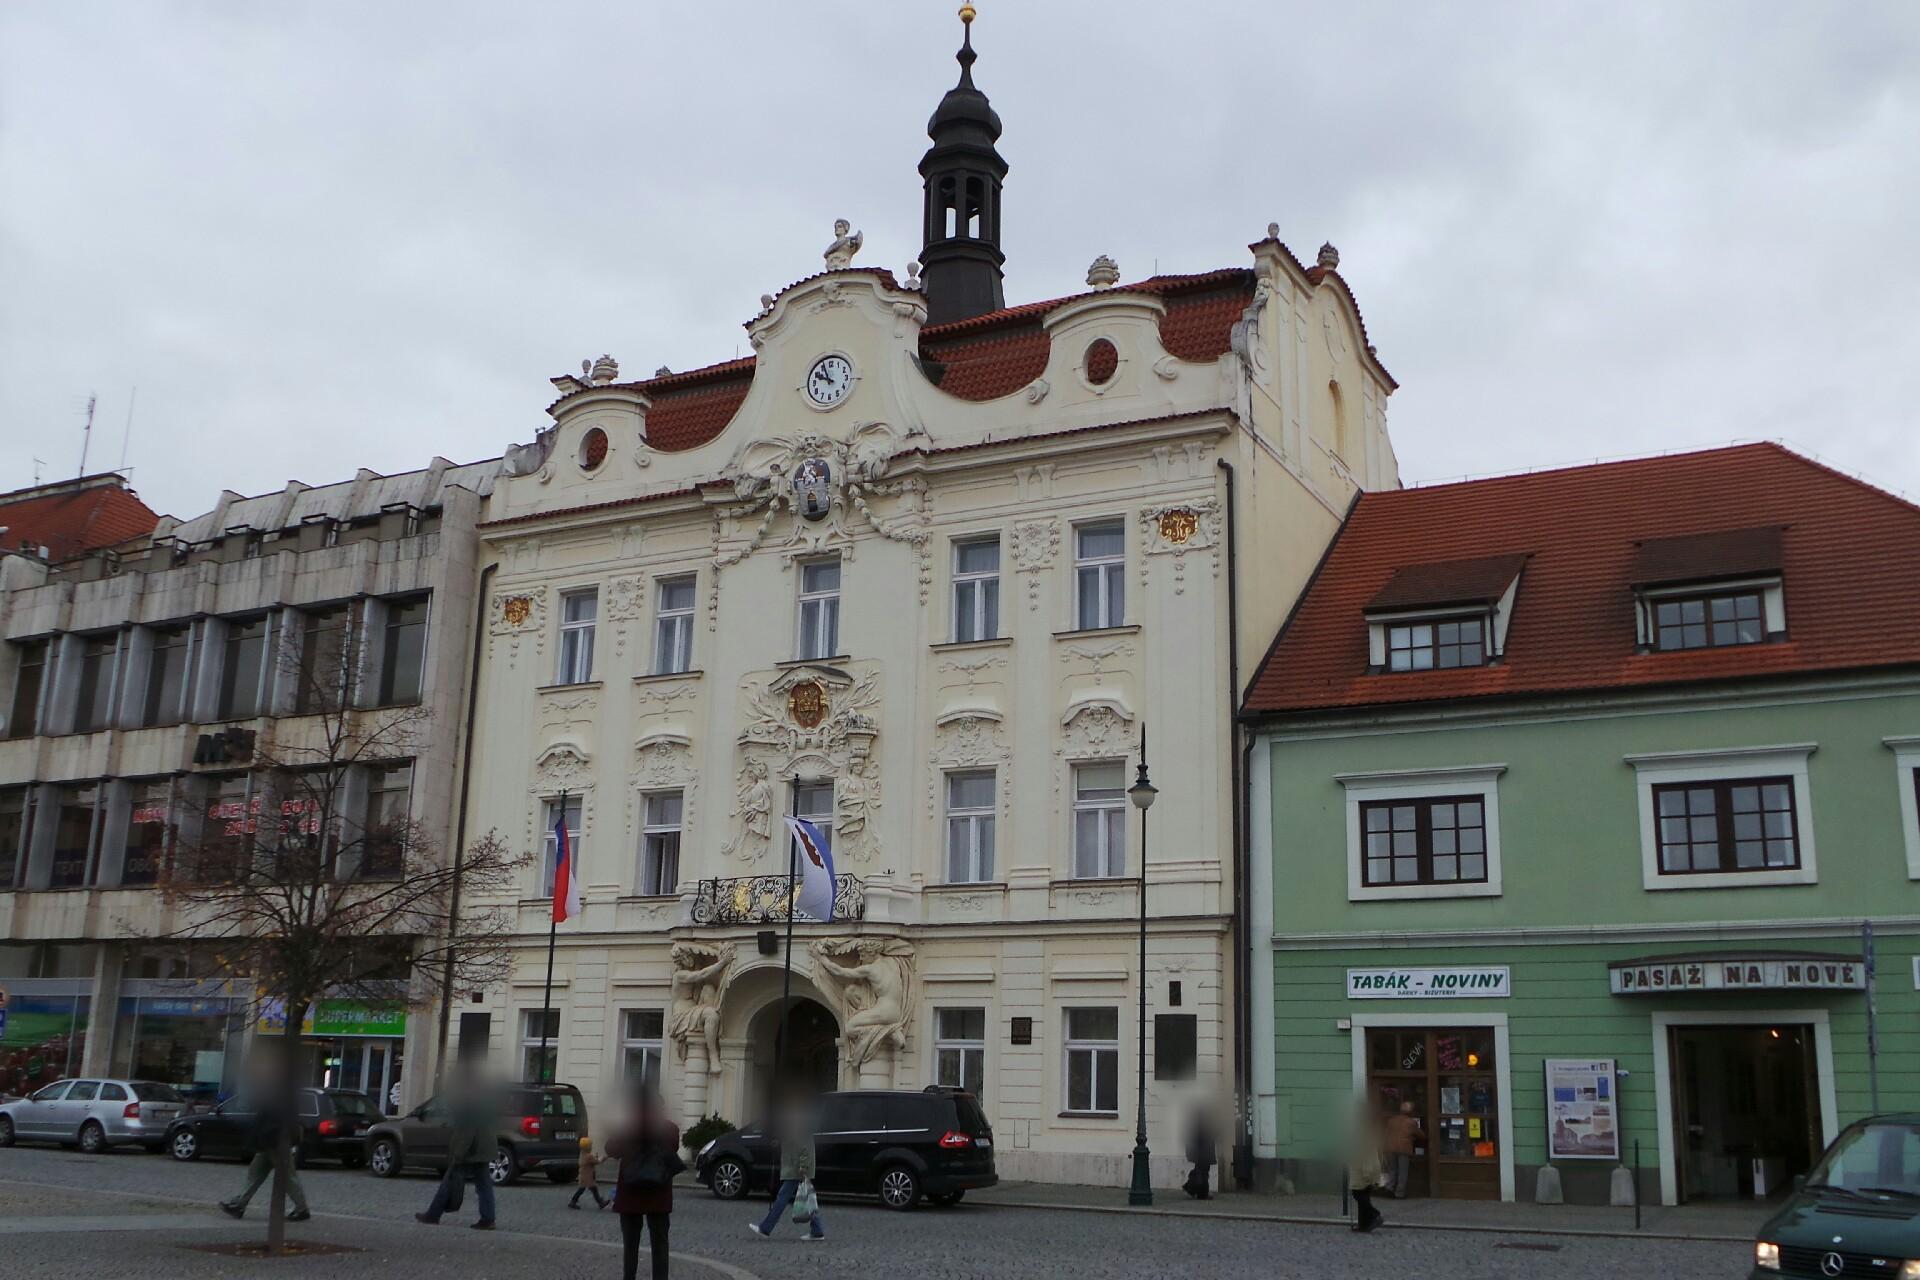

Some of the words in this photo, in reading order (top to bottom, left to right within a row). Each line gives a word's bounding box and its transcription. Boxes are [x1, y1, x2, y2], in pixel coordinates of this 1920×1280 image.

[1352, 971, 1411, 989] TABÁK
[1430, 973, 1504, 989] NOVINY
[1623, 964, 1701, 988] PASÁŽ
[1726, 966, 1762, 984] NA
[1786, 962, 1854, 984] NOVÉ
[1402, 1042, 1425, 1069] SLEVA
